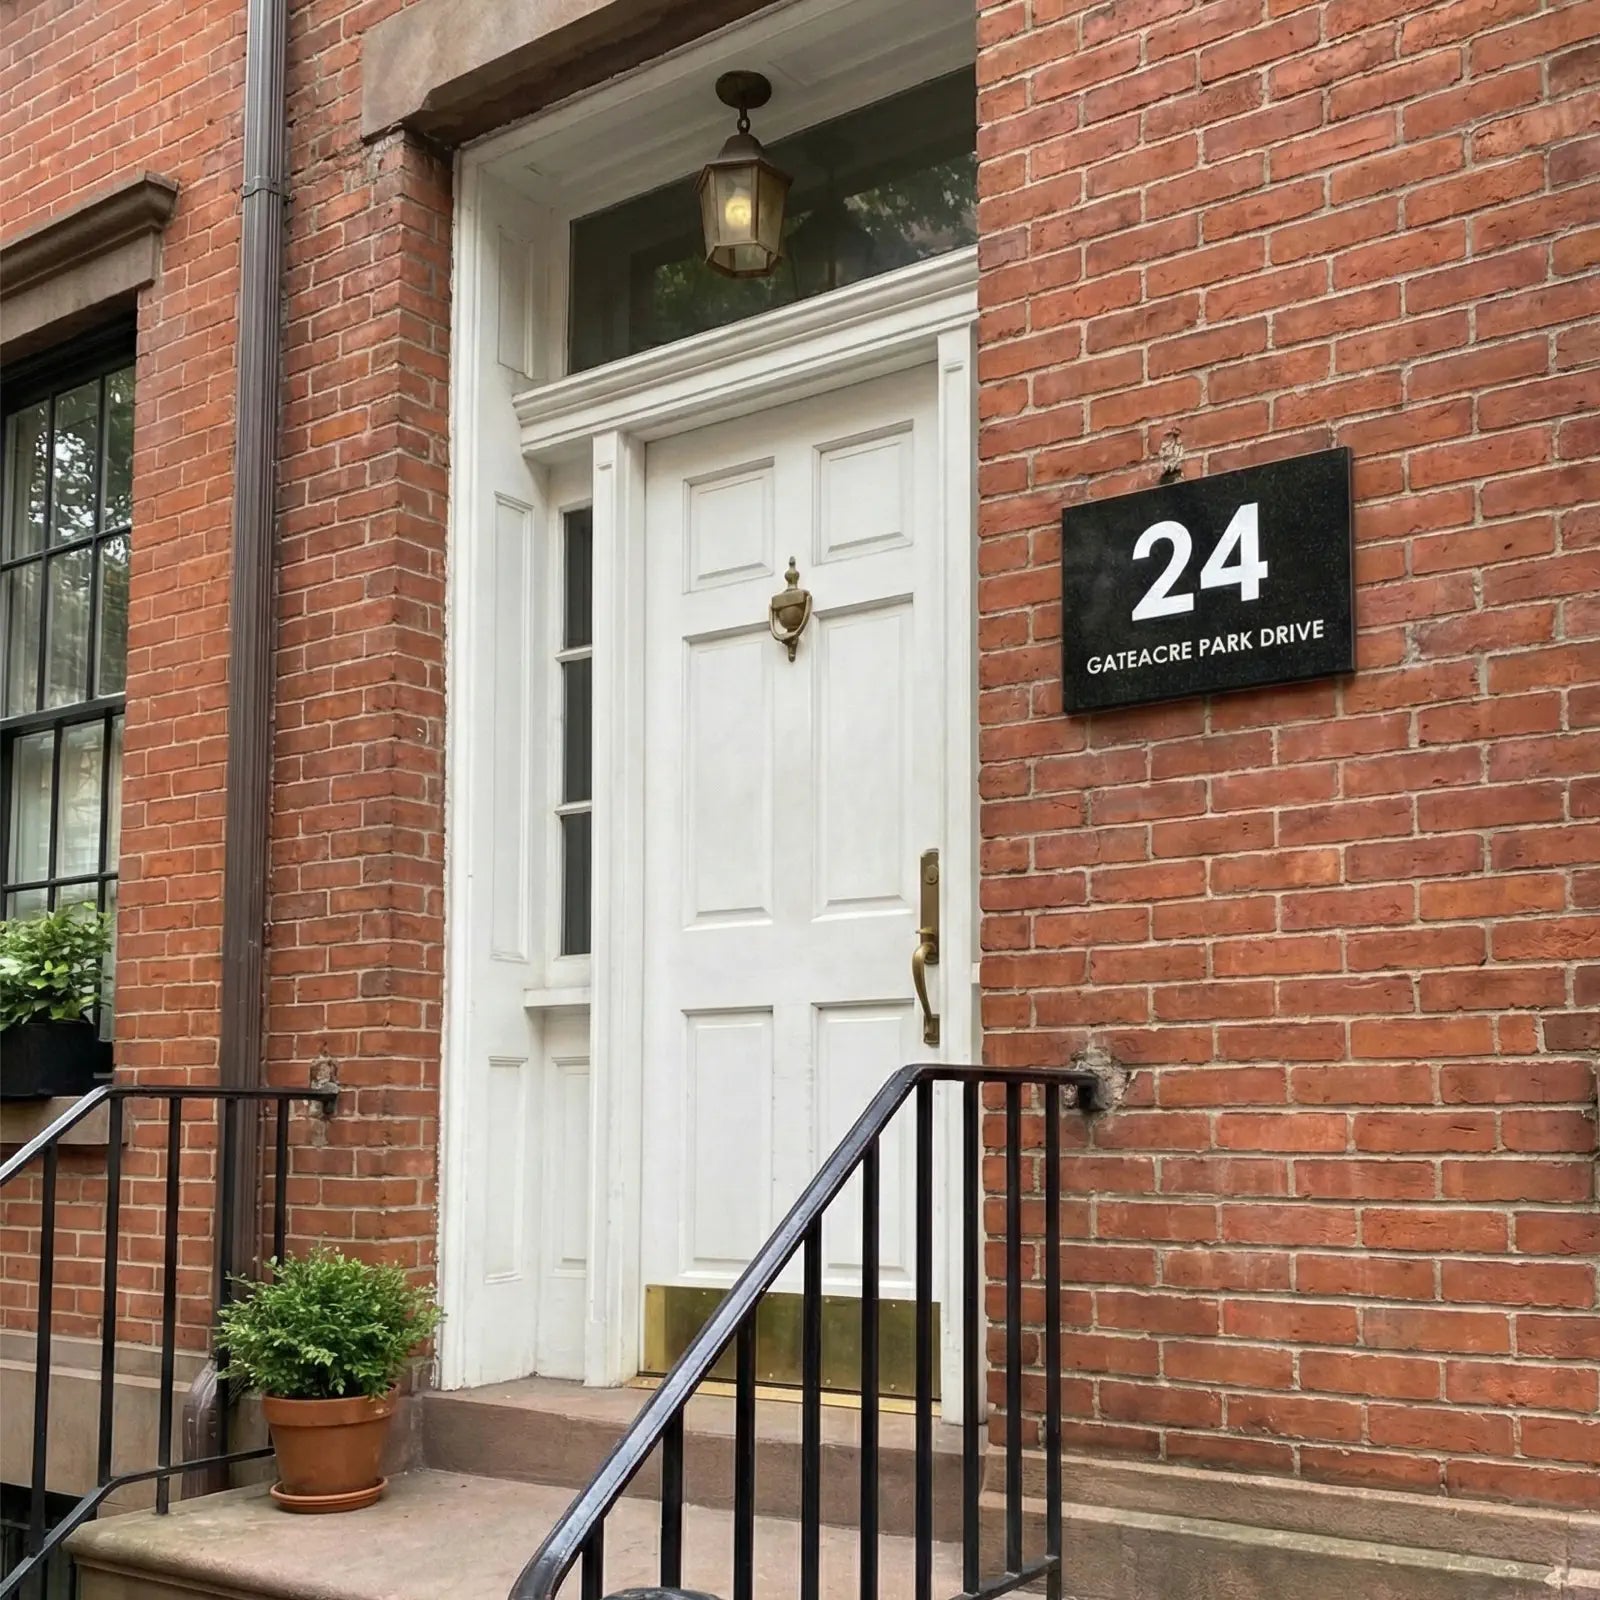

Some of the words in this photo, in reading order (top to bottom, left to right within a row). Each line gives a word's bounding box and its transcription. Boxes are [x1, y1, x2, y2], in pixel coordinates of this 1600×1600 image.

[1131, 502, 1269, 622] 24
[1086, 641, 1192, 675] GATEACRE
[1199, 630, 1253, 657] PARK
[1260, 619, 1325, 647] DRIVE
